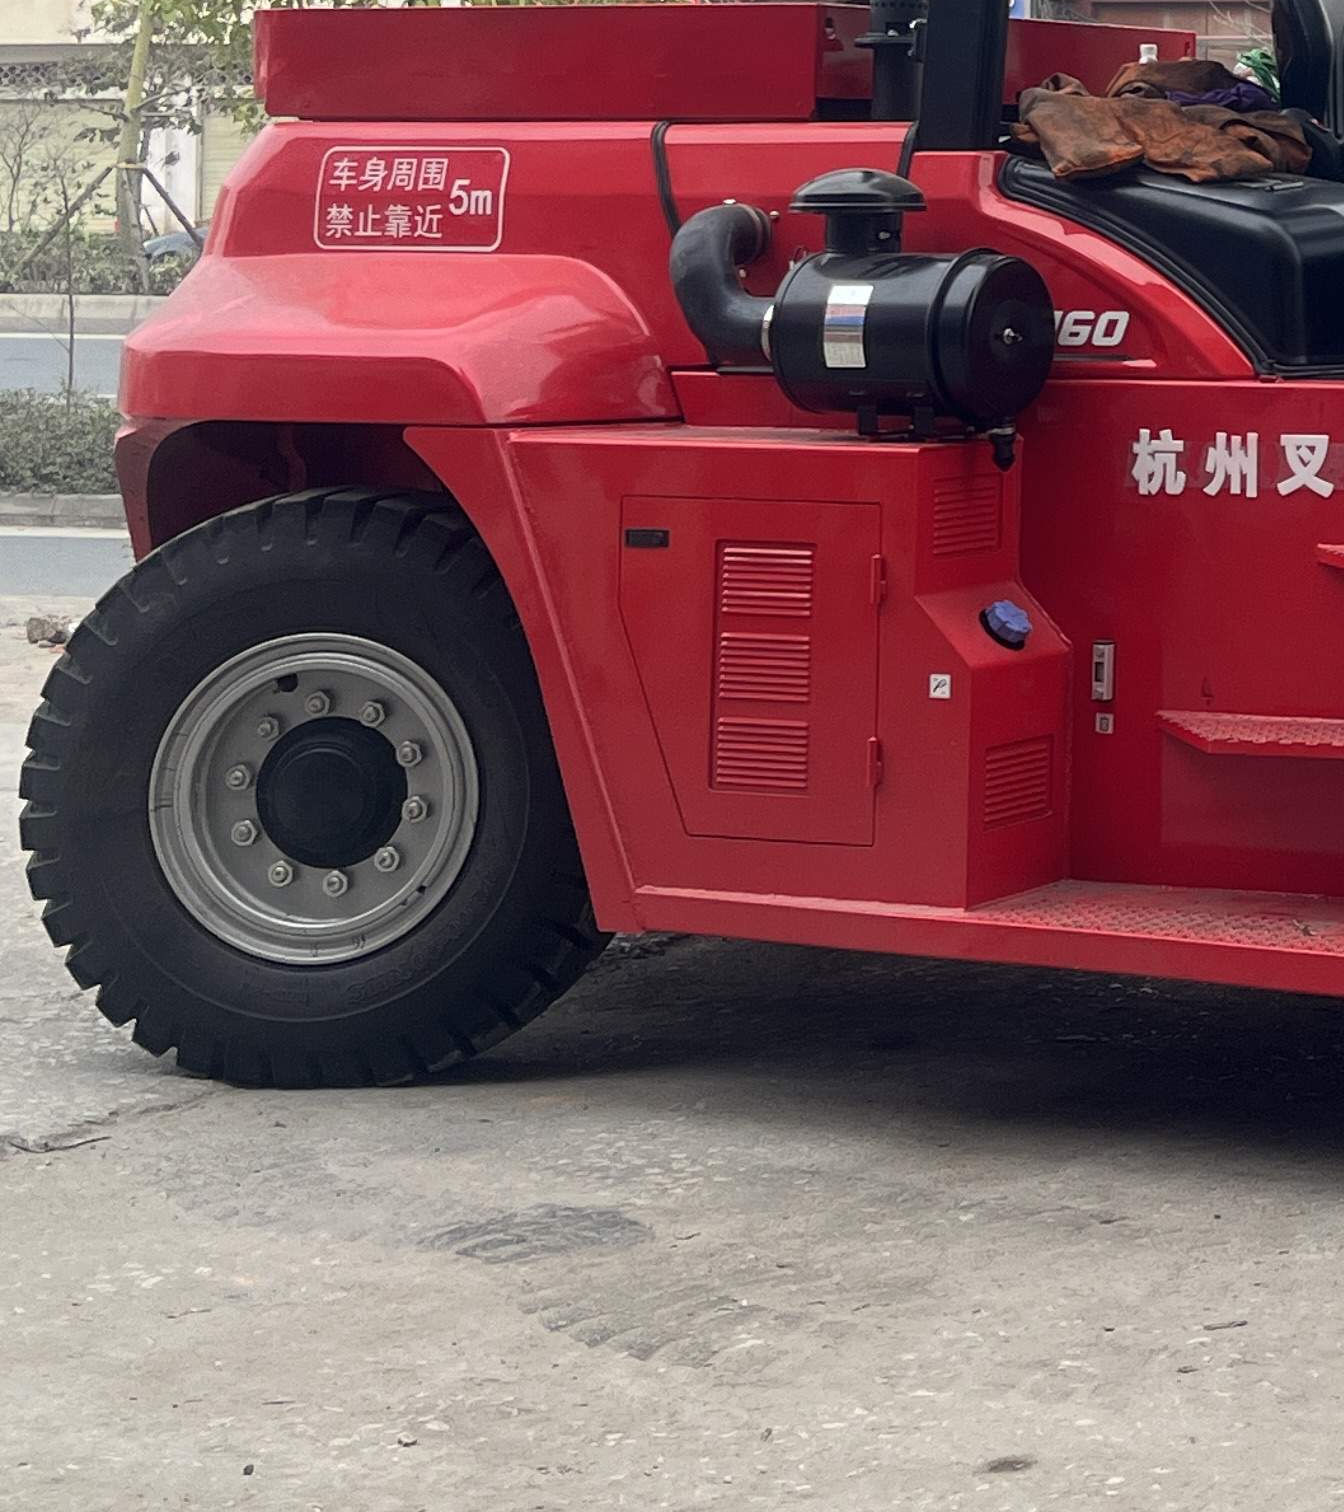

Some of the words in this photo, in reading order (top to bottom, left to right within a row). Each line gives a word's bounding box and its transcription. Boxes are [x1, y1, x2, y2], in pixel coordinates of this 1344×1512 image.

[329, 157, 448, 192] 车身周围
[448, 178, 493, 217] 5m
[325, 203, 443, 239] 禁止靠近
